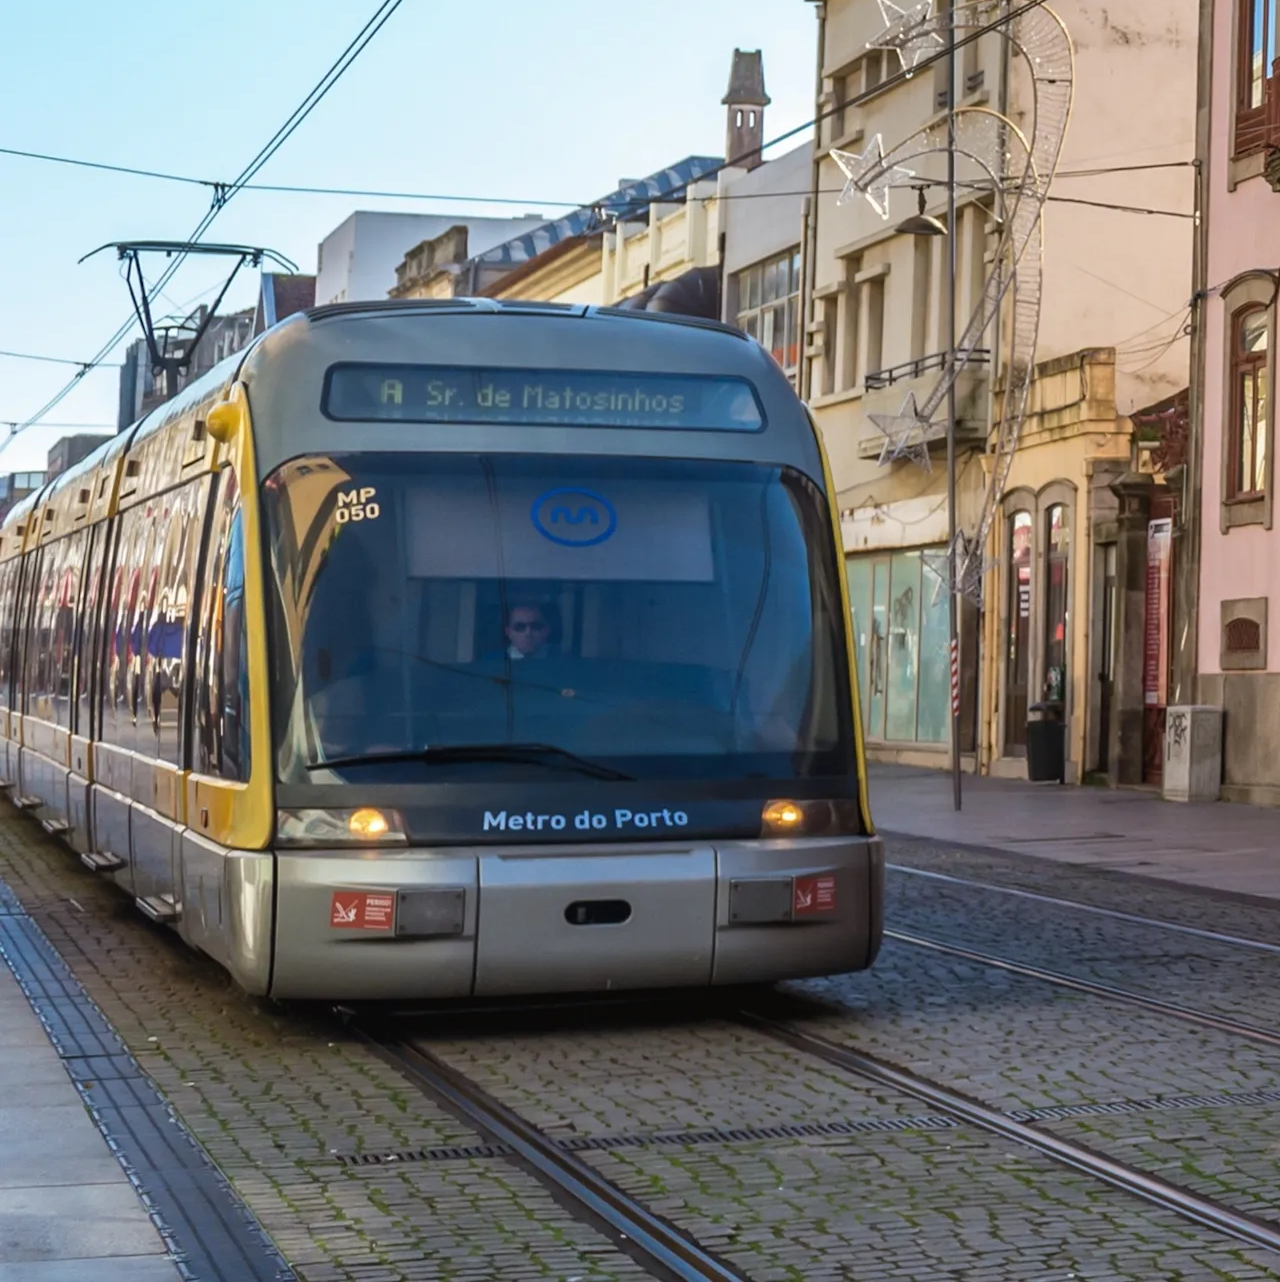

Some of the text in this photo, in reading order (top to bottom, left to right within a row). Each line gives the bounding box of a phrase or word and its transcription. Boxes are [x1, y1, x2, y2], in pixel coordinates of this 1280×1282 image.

[426, 380, 464, 407] Sr.
[477, 383, 510, 408] de
[522, 386, 685, 412] Matosinhos
[337, 487, 376, 507] MP
[335, 503, 379, 523] 050
[483, 808, 688, 830] Metro do Porto
